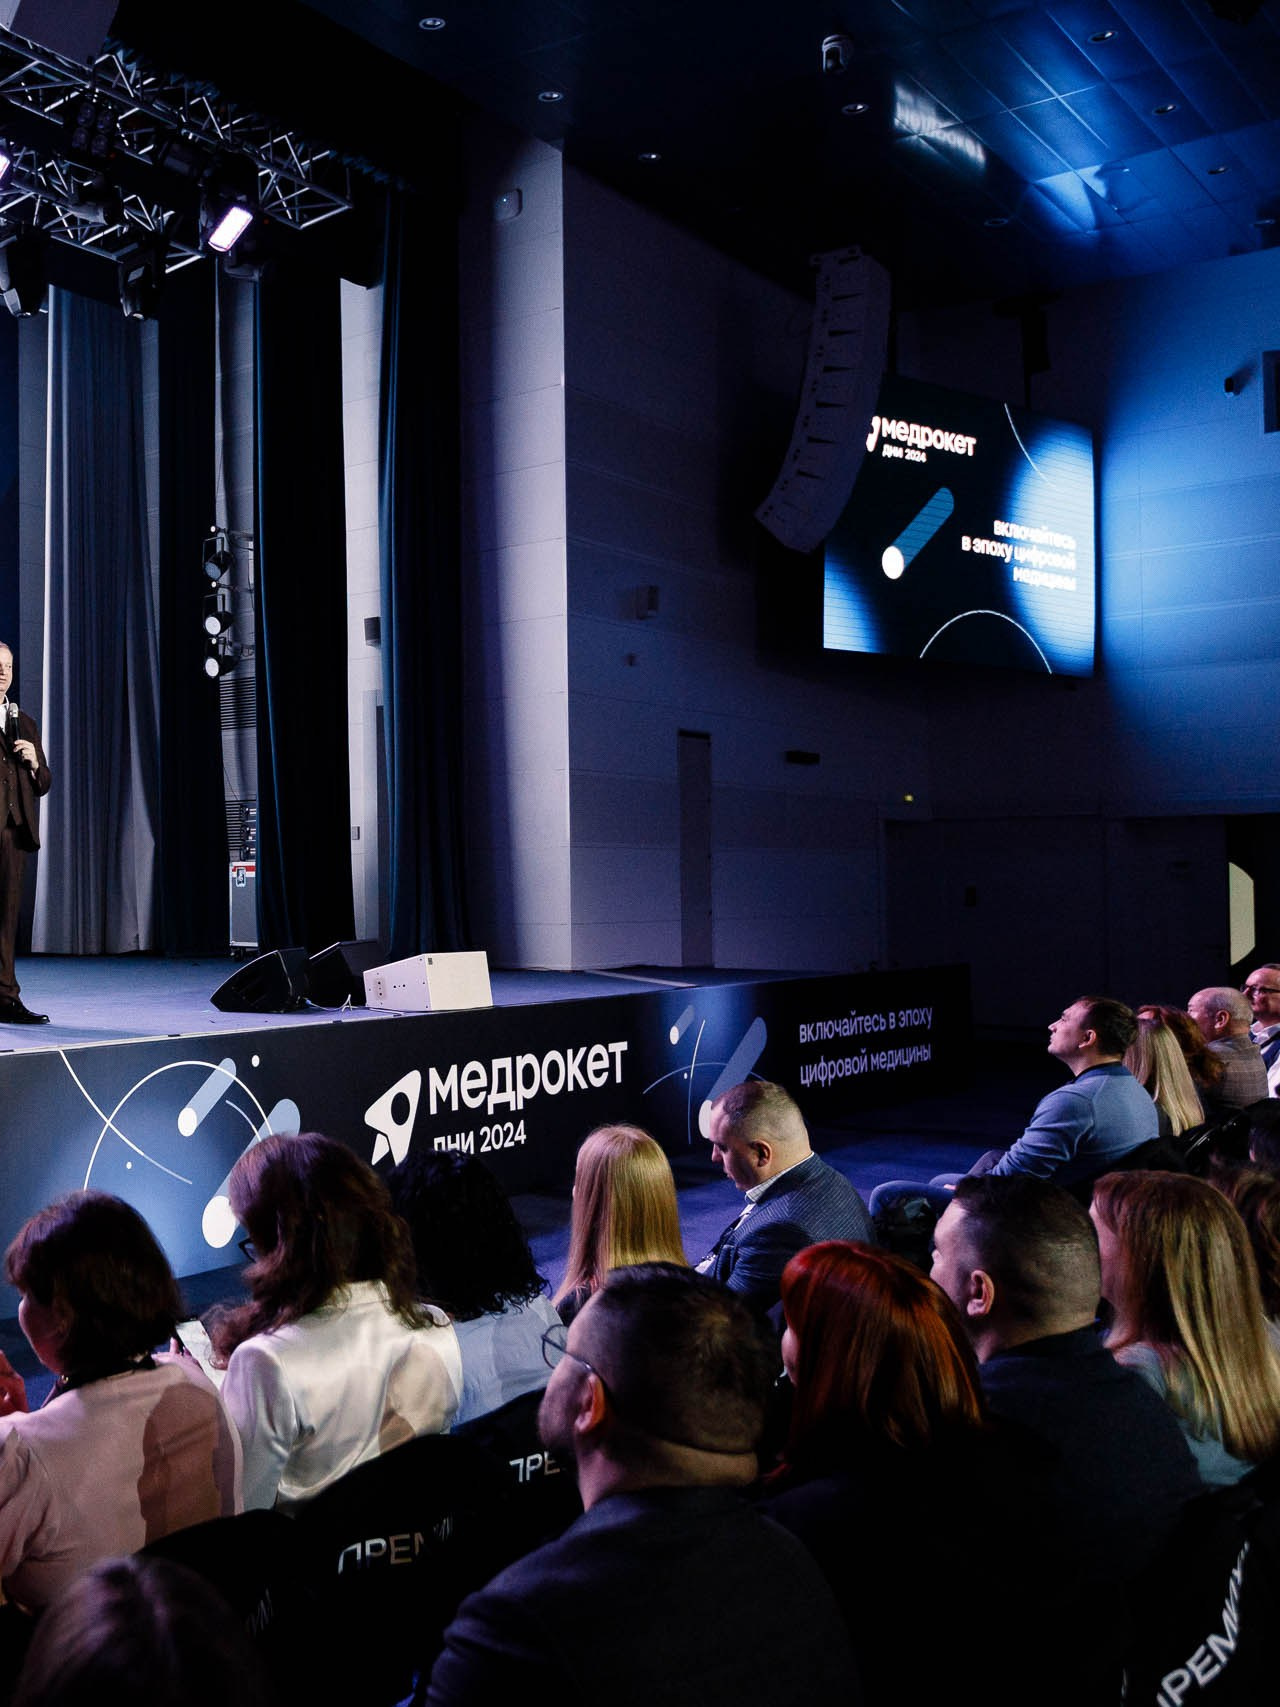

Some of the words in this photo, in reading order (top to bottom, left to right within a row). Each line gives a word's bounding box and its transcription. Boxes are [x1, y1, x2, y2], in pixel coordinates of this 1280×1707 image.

[882, 417, 976, 456] медрокет
[904, 448, 927, 463] 2024
[972, 538, 1013, 563] эпоху
[799, 1009, 887, 1043] включайтесь
[889, 1012, 896, 1029] в
[898, 1007, 933, 1029] эпоху
[429, 1041, 628, 1115] медрокет
[800, 1047, 868, 1087] цифровой
[870, 1043, 932, 1072] медицины
[479, 1119, 527, 1153] 2024
